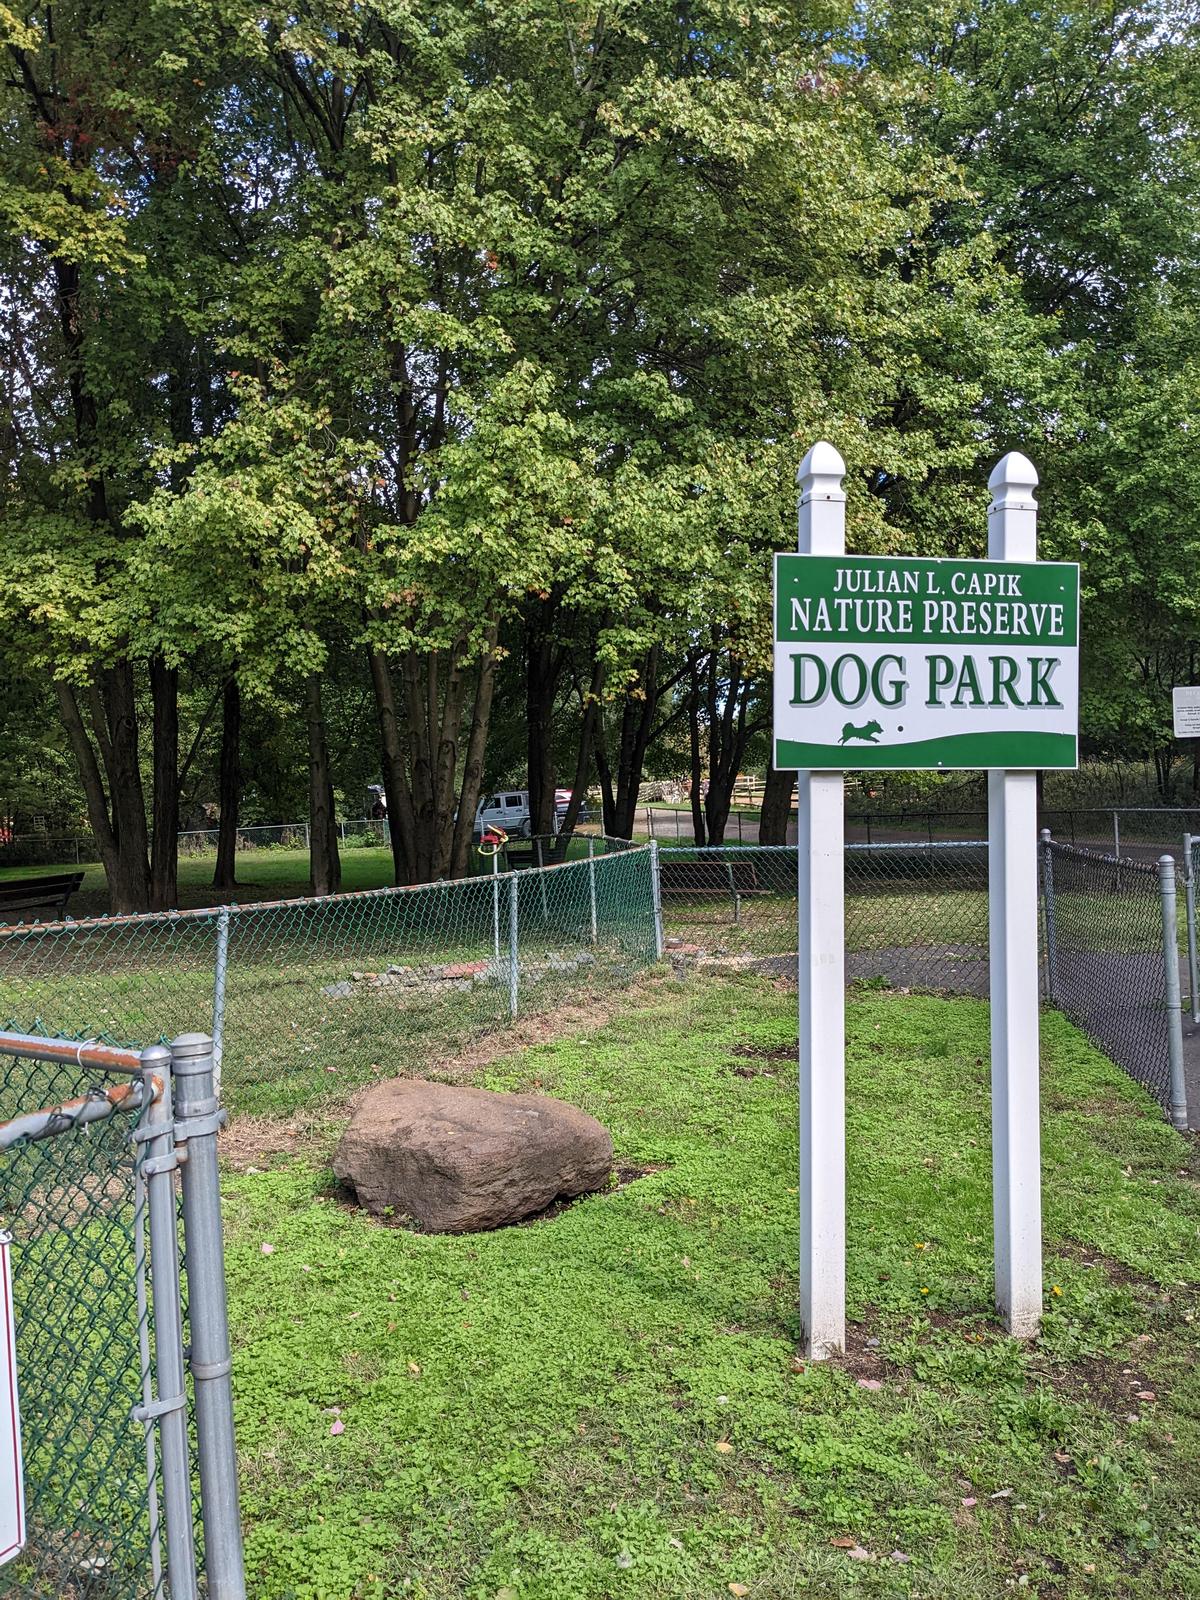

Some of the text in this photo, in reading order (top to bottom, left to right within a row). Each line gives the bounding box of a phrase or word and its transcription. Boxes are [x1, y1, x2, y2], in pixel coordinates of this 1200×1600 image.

[833, 569, 1023, 597] JULIAN L. CAPIK
[790, 598, 1064, 636] NATURE PRESERVE
[788, 653, 1064, 710] DOG PARK
